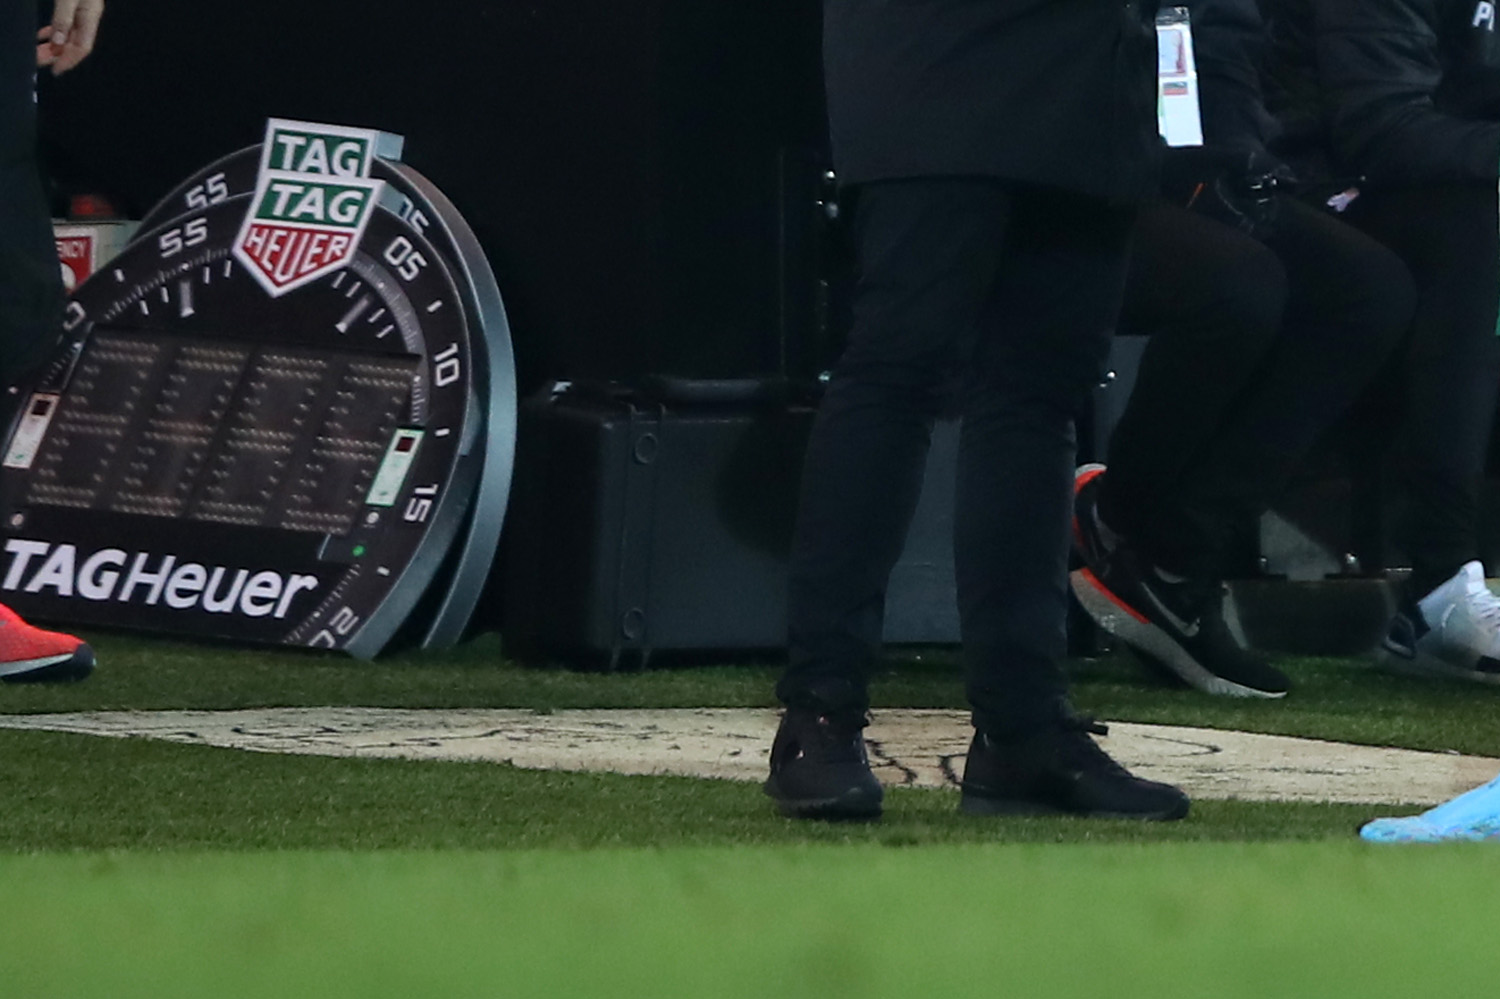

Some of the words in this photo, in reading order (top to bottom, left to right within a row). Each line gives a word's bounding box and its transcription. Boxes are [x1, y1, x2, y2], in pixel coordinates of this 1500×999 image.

[276, 134, 361, 178] TAG
[271, 183, 364, 224] TAG
[159, 218, 207, 258] 55
[246, 227, 350, 283] HEUER
[384, 236, 427, 281] 05
[434, 343, 460, 387] 10
[404, 483, 439, 522] 15
